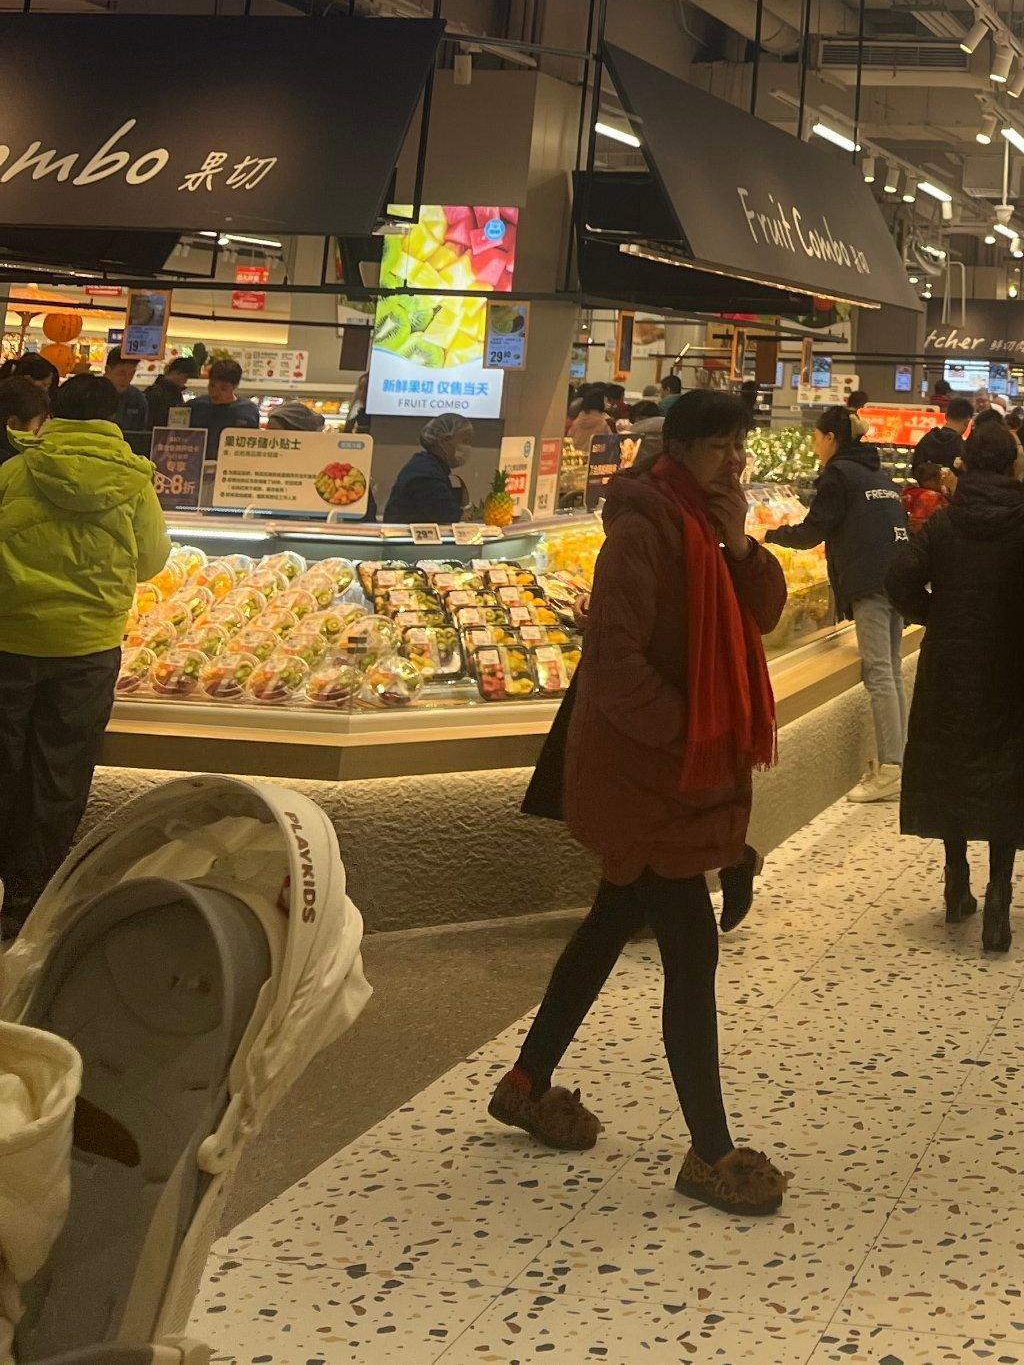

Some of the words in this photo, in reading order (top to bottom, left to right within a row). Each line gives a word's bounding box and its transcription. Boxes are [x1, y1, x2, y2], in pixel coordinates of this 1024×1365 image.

[178, 151, 278, 192] 果切
[737, 186, 796, 253] Fruit
[792, 206, 851, 267] Combo
[382, 379, 434, 395] 新鲜果切
[437, 380, 489, 396] 仅售当天
[397, 398, 428, 408] FRUIT
[429, 399, 470, 410] COMBO
[224, 435, 302, 451] 果切存储小贴士
[284, 811, 316, 924] PLAYKIDS
